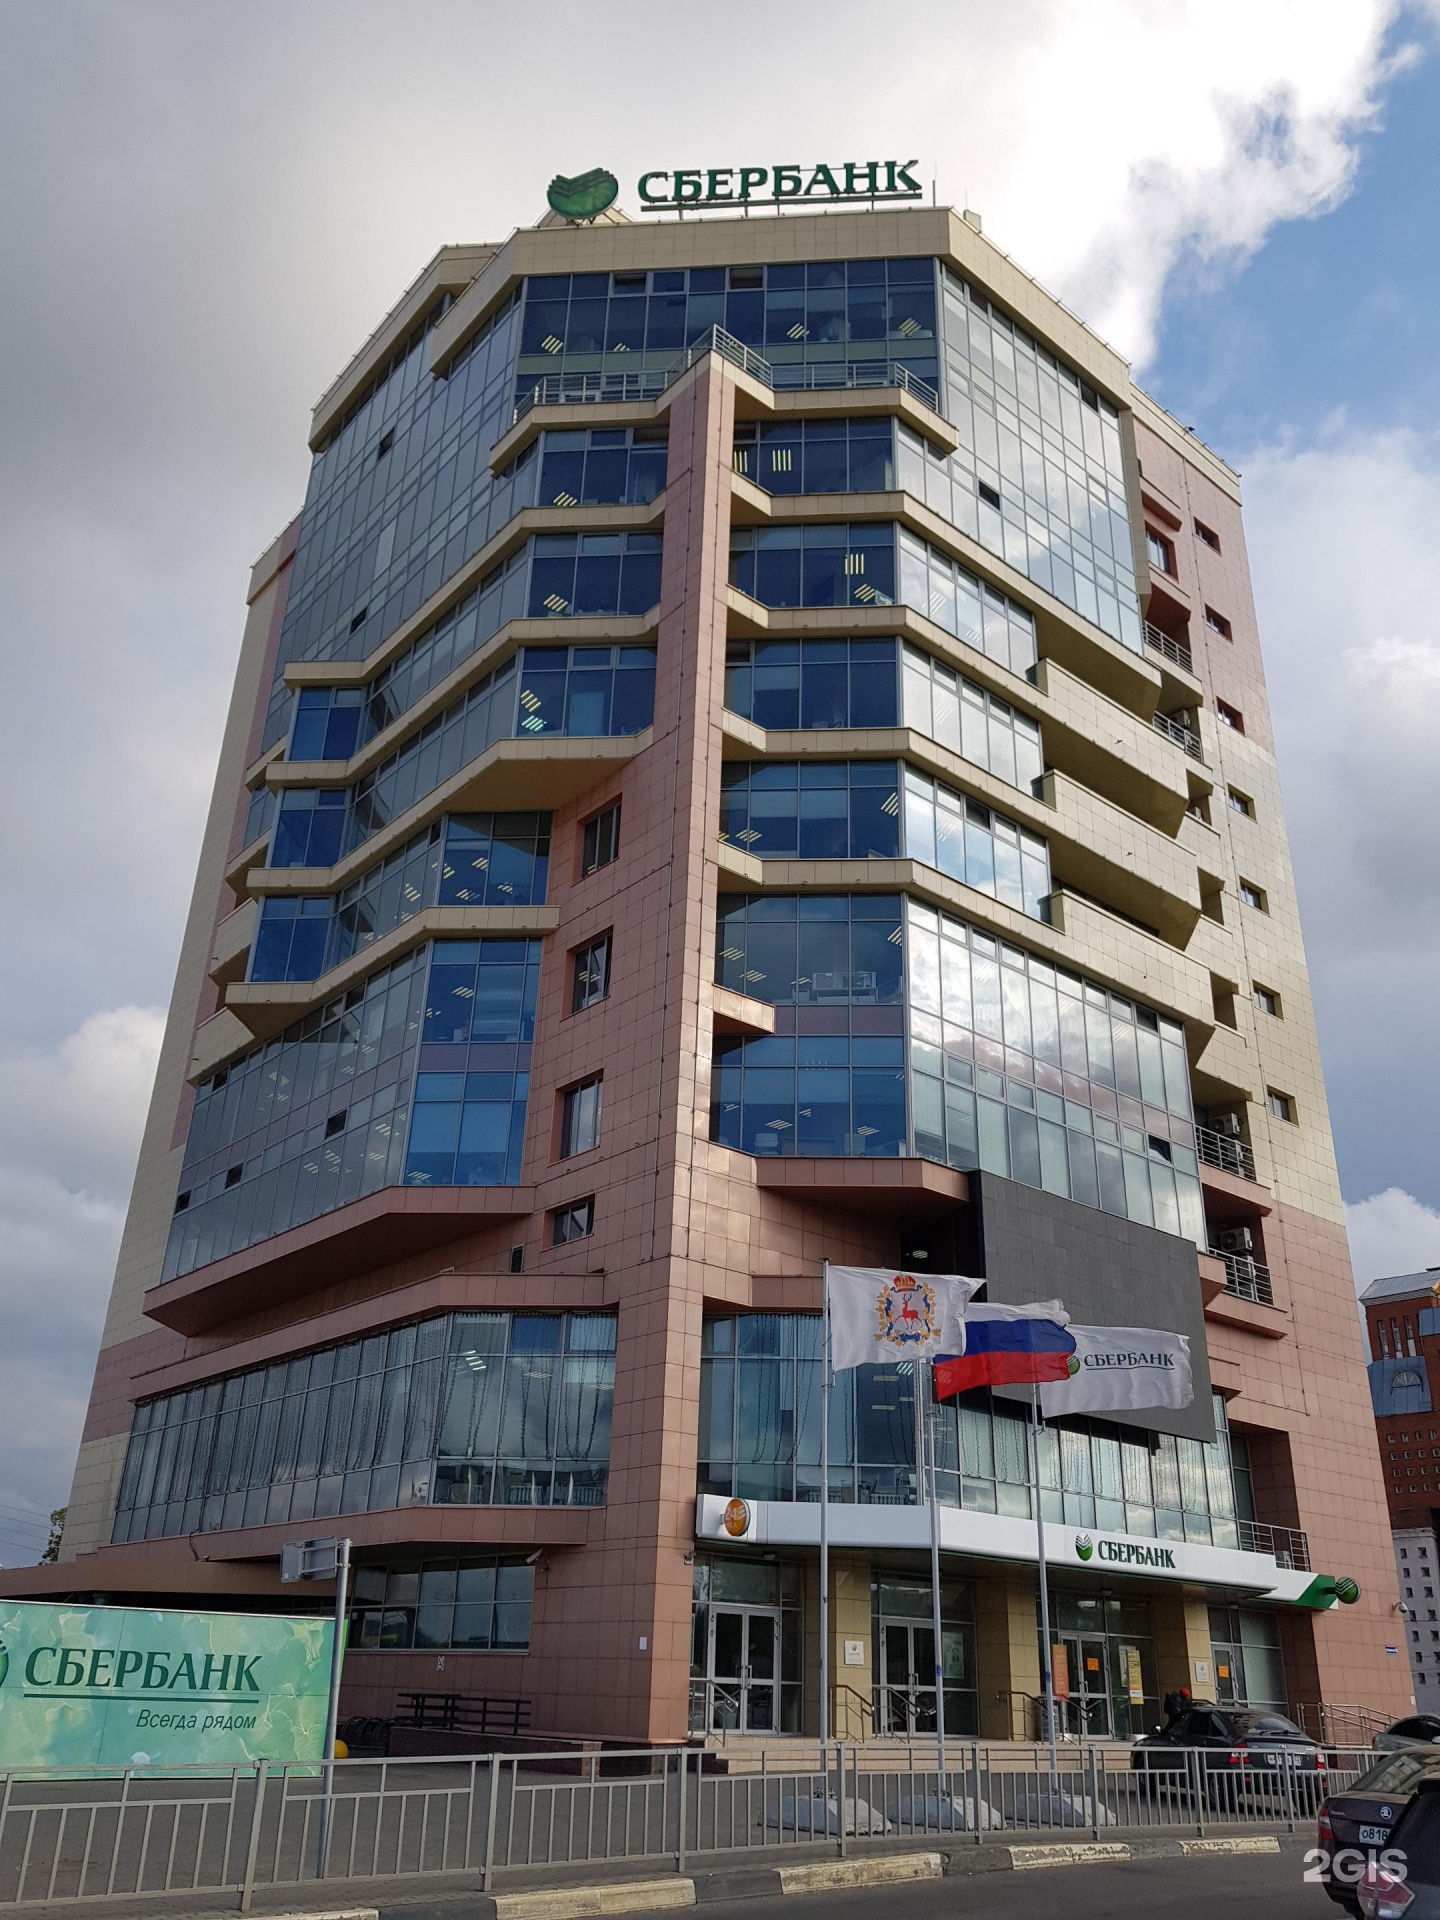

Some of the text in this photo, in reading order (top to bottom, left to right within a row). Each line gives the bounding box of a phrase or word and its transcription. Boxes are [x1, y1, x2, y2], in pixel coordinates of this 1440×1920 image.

[637, 159, 922, 203] СБЕРБАНК
[1084, 1352, 1174, 1368] СБЕРБАНК
[1098, 1540, 1176, 1569] СБЕРБАНК
[25, 1646, 263, 1691] СБЕРБАНК
[136, 1709, 257, 1733] Всегда рядом
